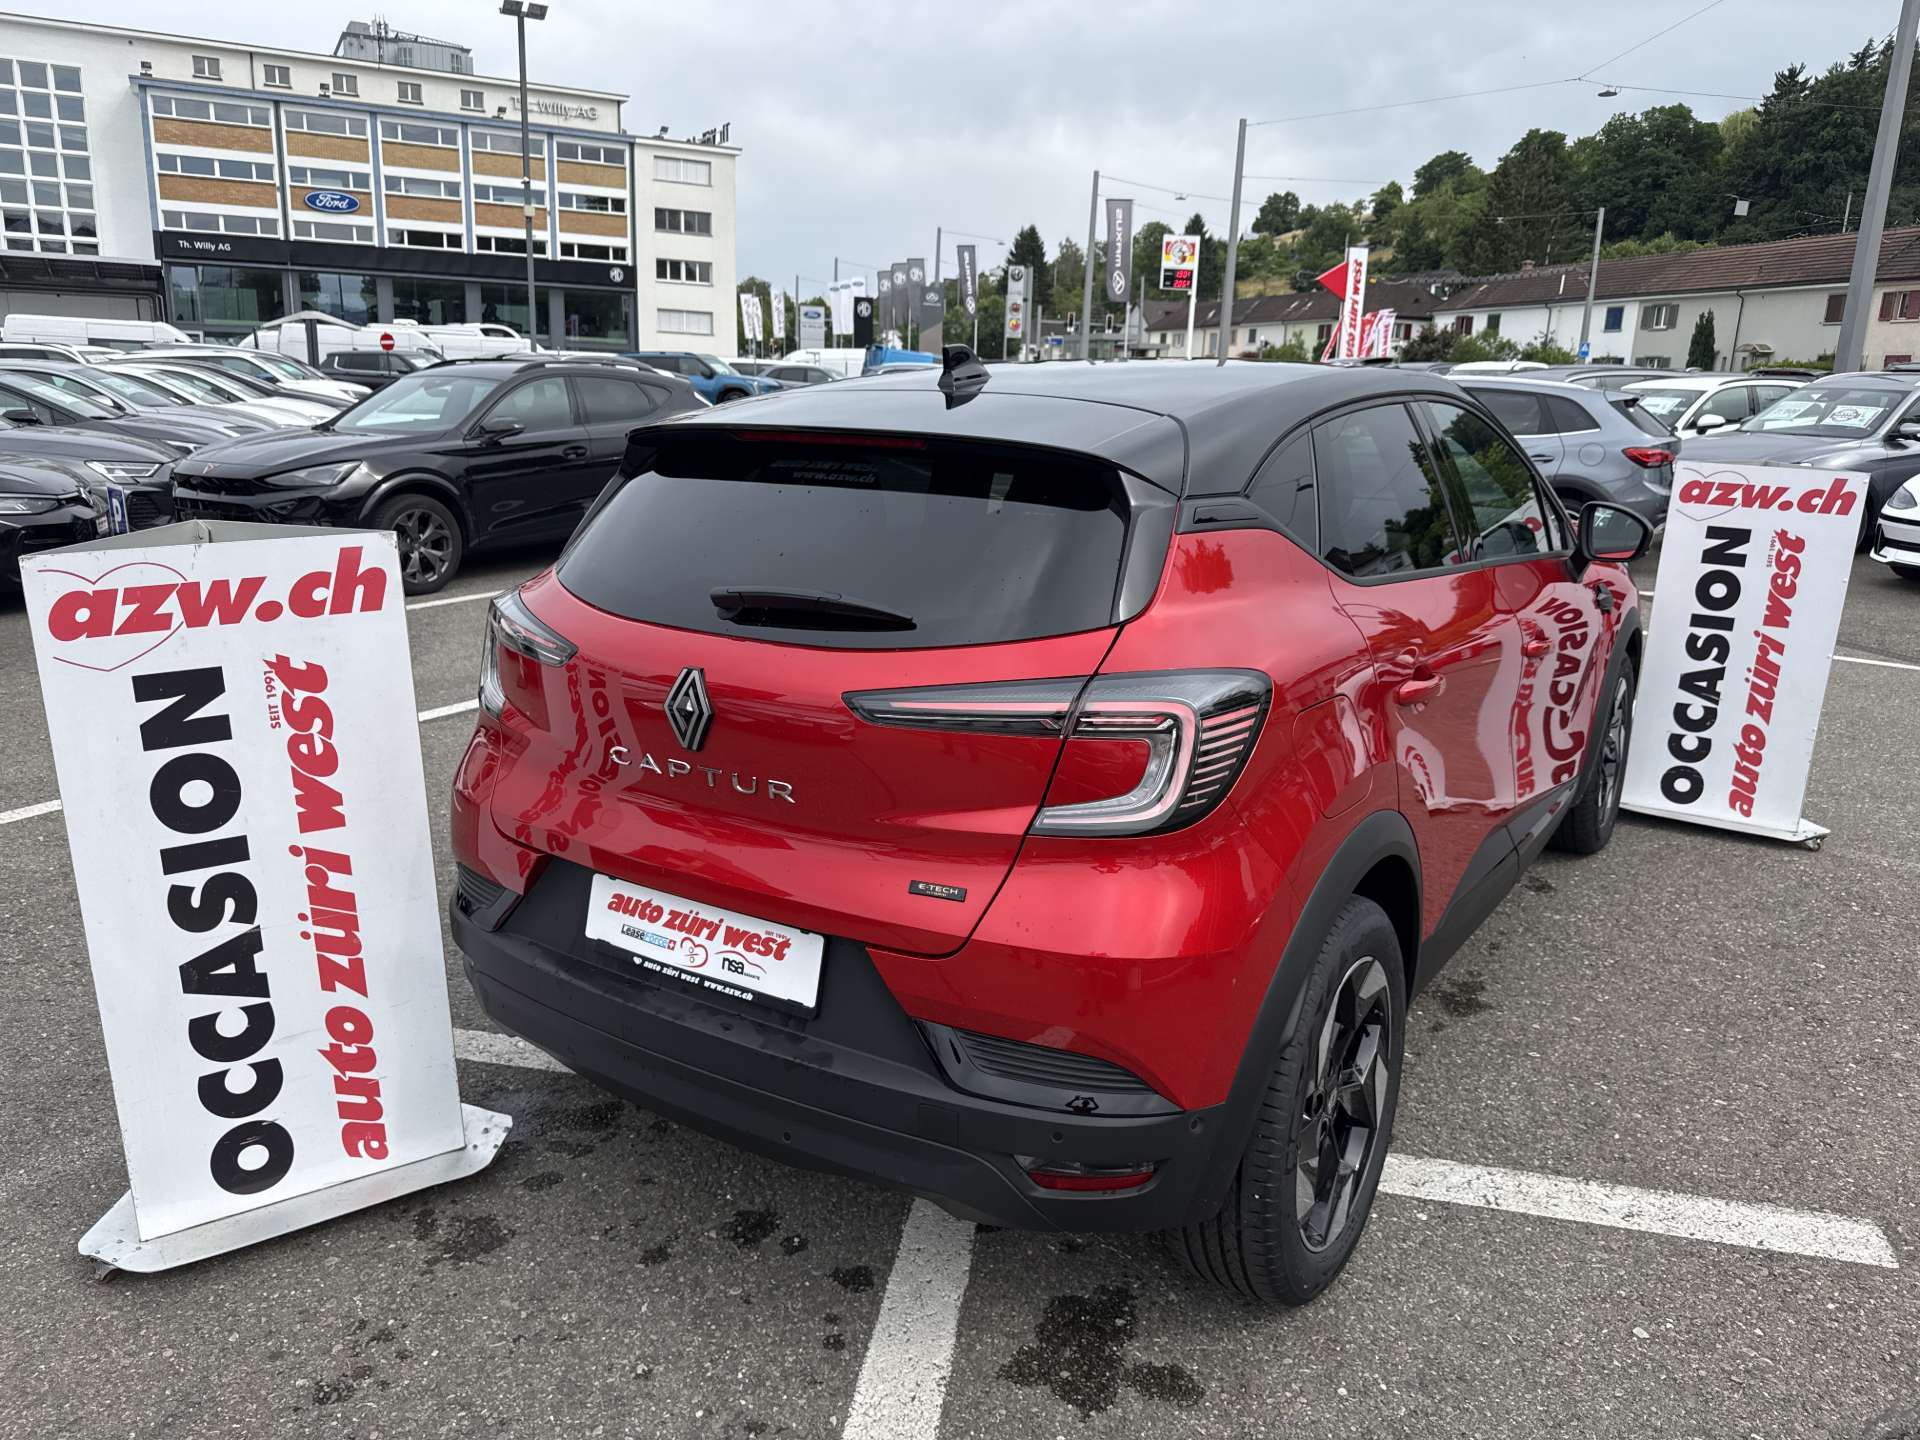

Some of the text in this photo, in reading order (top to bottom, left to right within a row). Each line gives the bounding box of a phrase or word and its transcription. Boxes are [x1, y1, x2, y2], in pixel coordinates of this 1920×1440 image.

[537, 100, 571, 121] Willy
[576, 105, 598, 121] AG
[178, 240, 231, 251] Th. Willy AG
[609, 267, 624, 283] MG
[1353, 258, 1362, 296] west
[1679, 478, 1858, 517] azw.ch
[48, 546, 388, 642] azw.ch
[1660, 526, 1752, 804] OCCASION
[1729, 528, 1806, 818] auto züri west
[263, 670, 281, 730] SEIT 1991
[608, 745, 797, 804] CAPTUR
[263, 653, 390, 1160] auto züri west
[918, 883, 959, 895] E-TECH
[132, 665, 295, 1195] OCCASION
[607, 893, 791, 961] auto züri west
[643, 960, 754, 1001] auto züri west www.azw.ch
[721, 957, 745, 975] nsa
